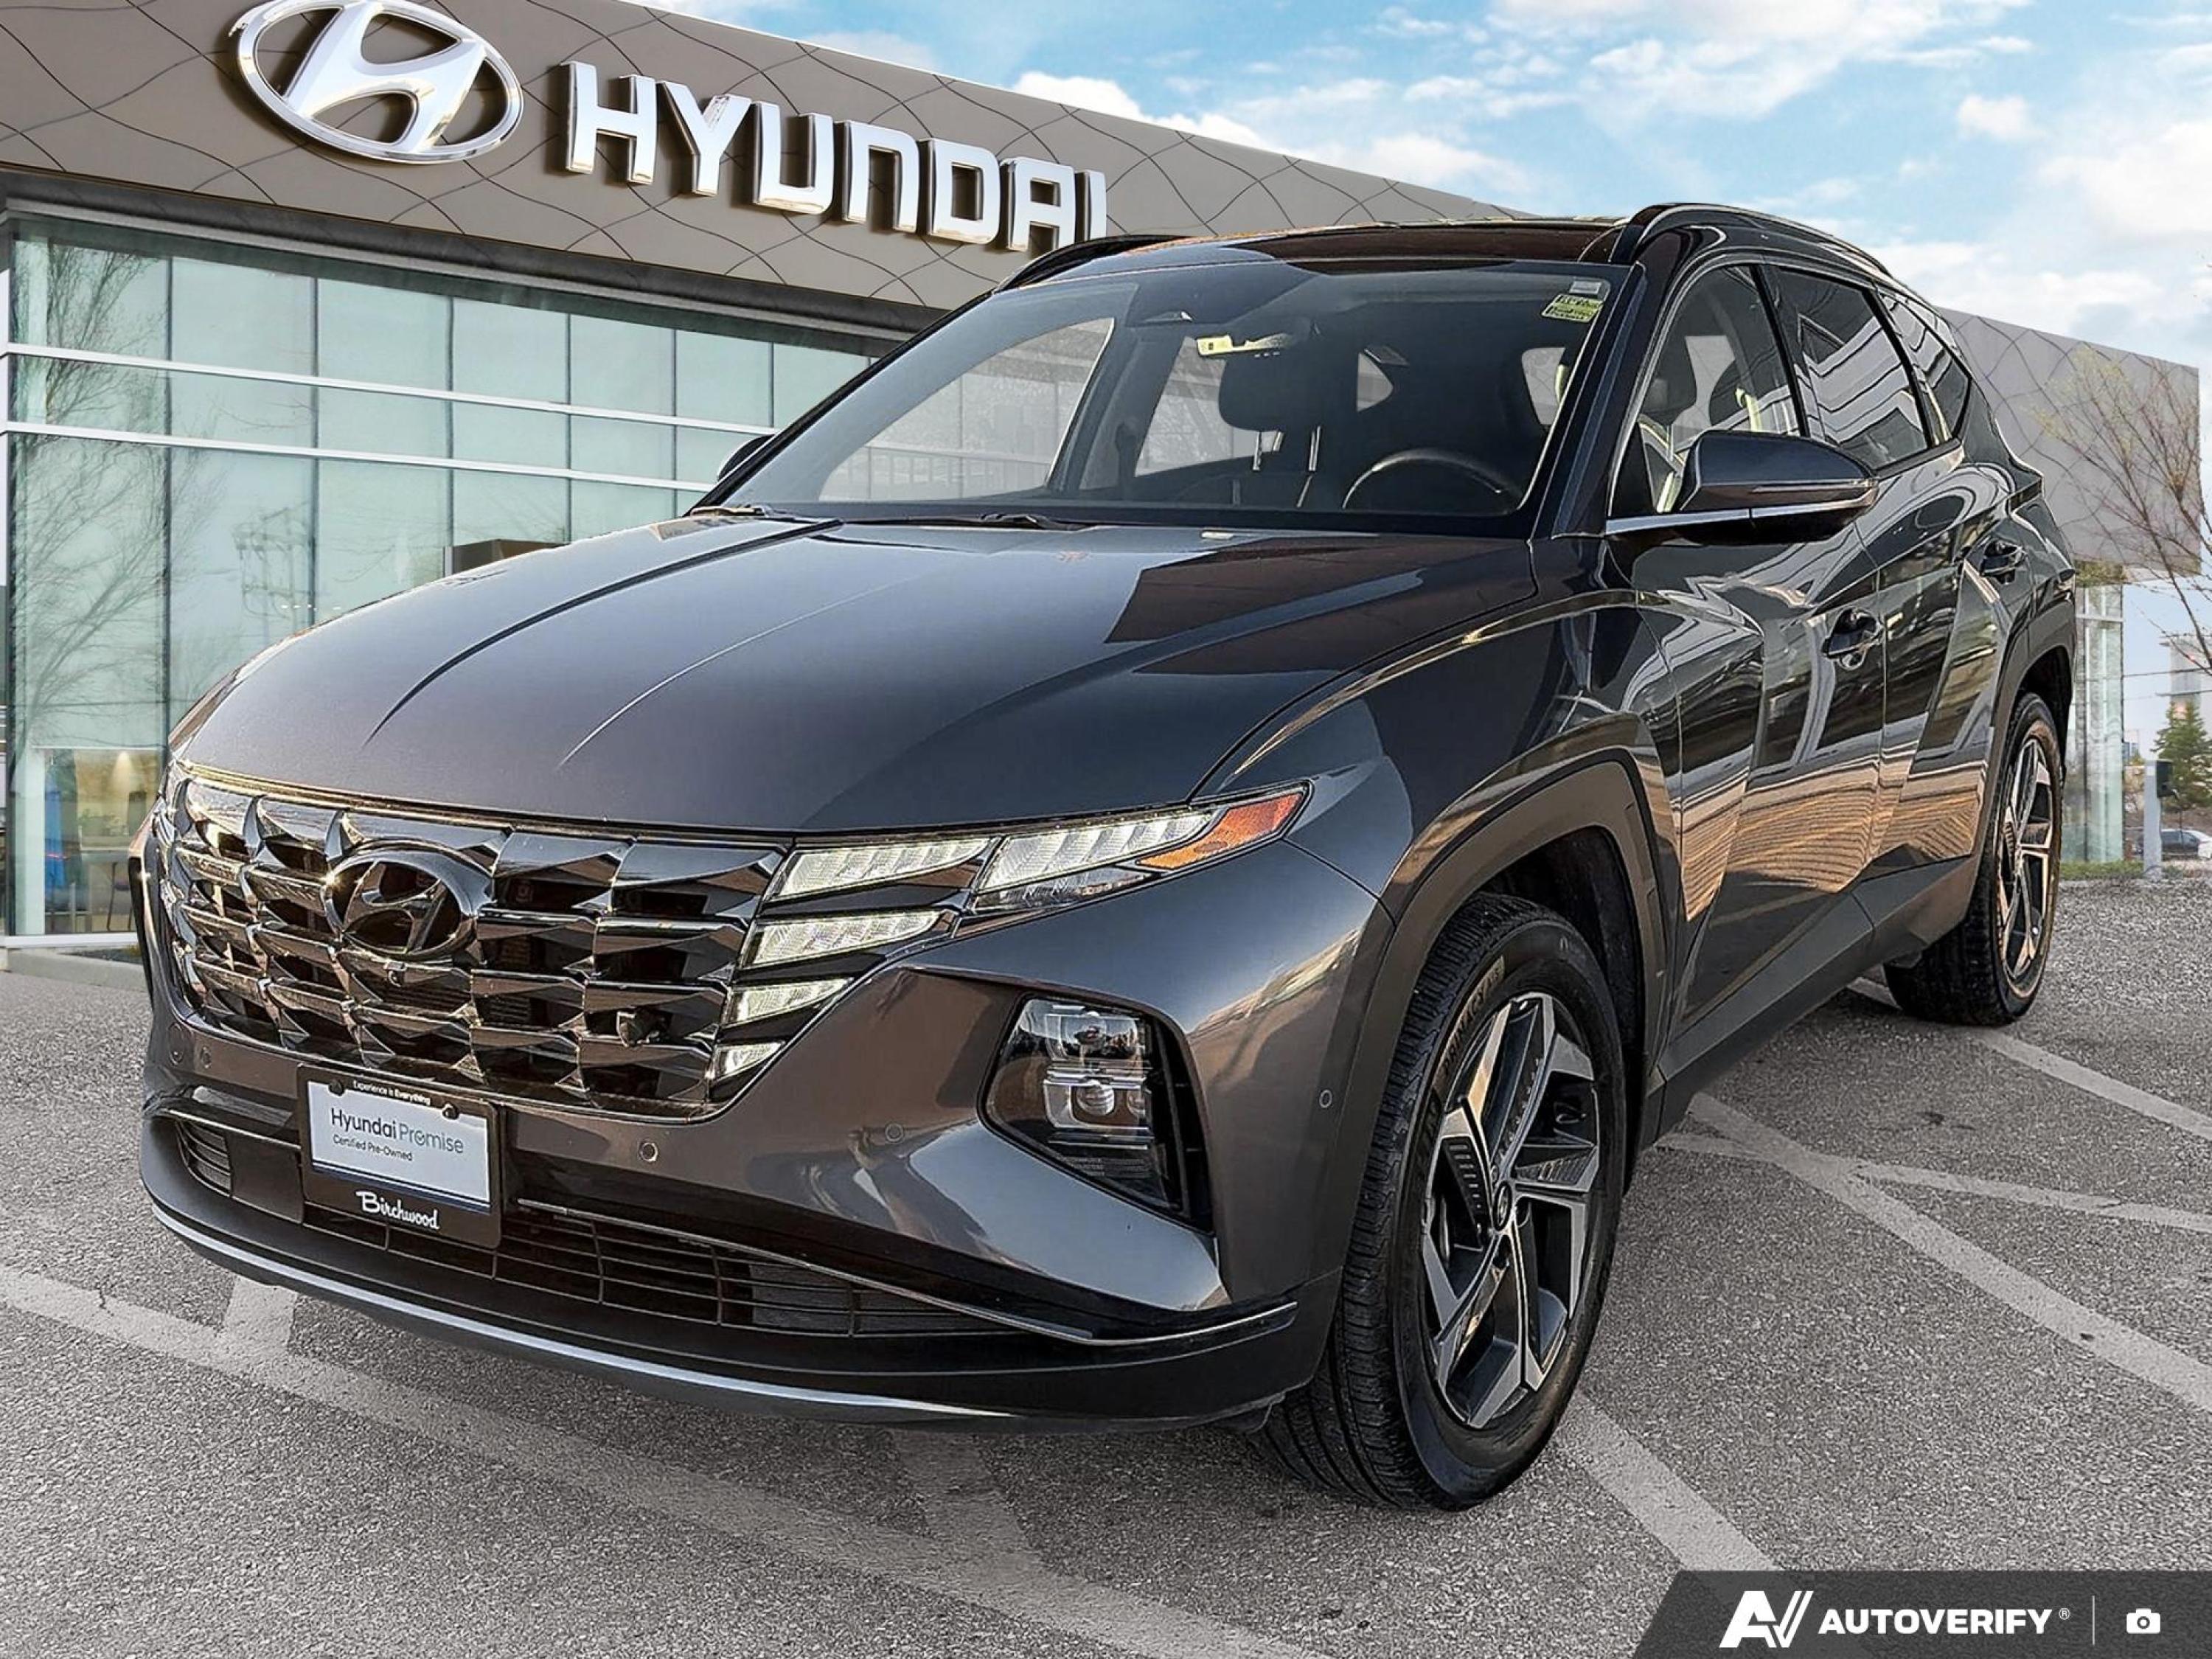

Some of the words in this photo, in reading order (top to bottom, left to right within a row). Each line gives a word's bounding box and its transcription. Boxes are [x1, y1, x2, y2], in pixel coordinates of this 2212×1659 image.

[561, 60, 1107, 252] HYUNDAI
[333, 1133, 366, 1150] Certified
[368, 1141, 413, 1161] Pre-Owned
[355, 1191, 440, 1230] Birchwood
